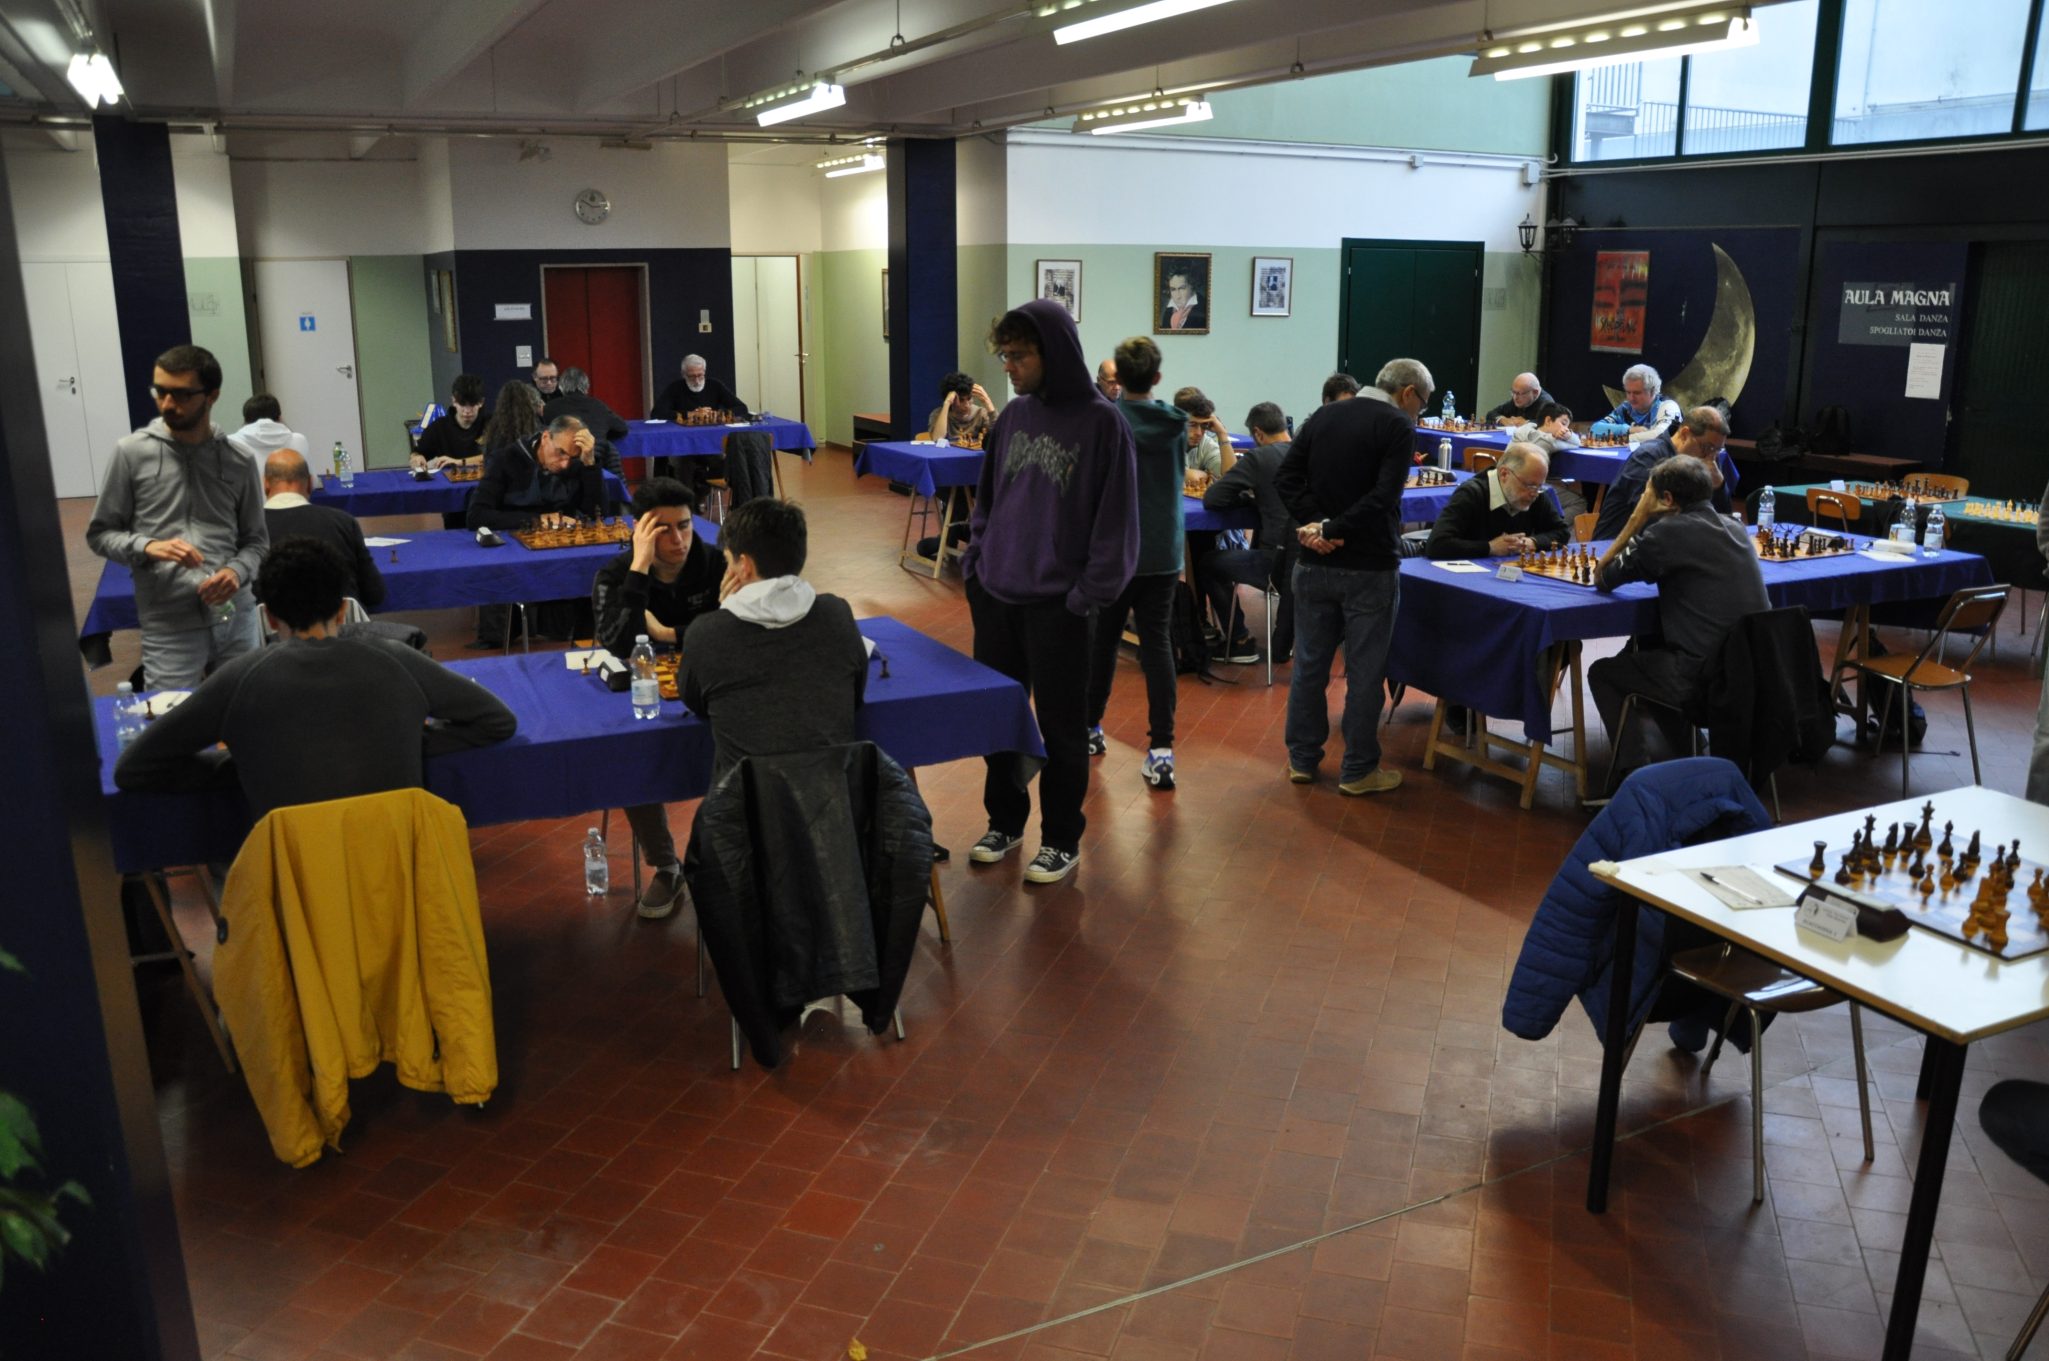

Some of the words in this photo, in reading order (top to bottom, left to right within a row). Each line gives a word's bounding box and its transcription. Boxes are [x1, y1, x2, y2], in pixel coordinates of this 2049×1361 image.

[1844, 289, 1885, 305] AULA
[1890, 289, 1950, 306] MAGNA
[1895, 313, 1916, 322] SALA
[1919, 314, 1949, 323] DANZA
[1869, 326, 1916, 336] SPOGLIATOI
[1918, 328, 1947, 337] DANZA
